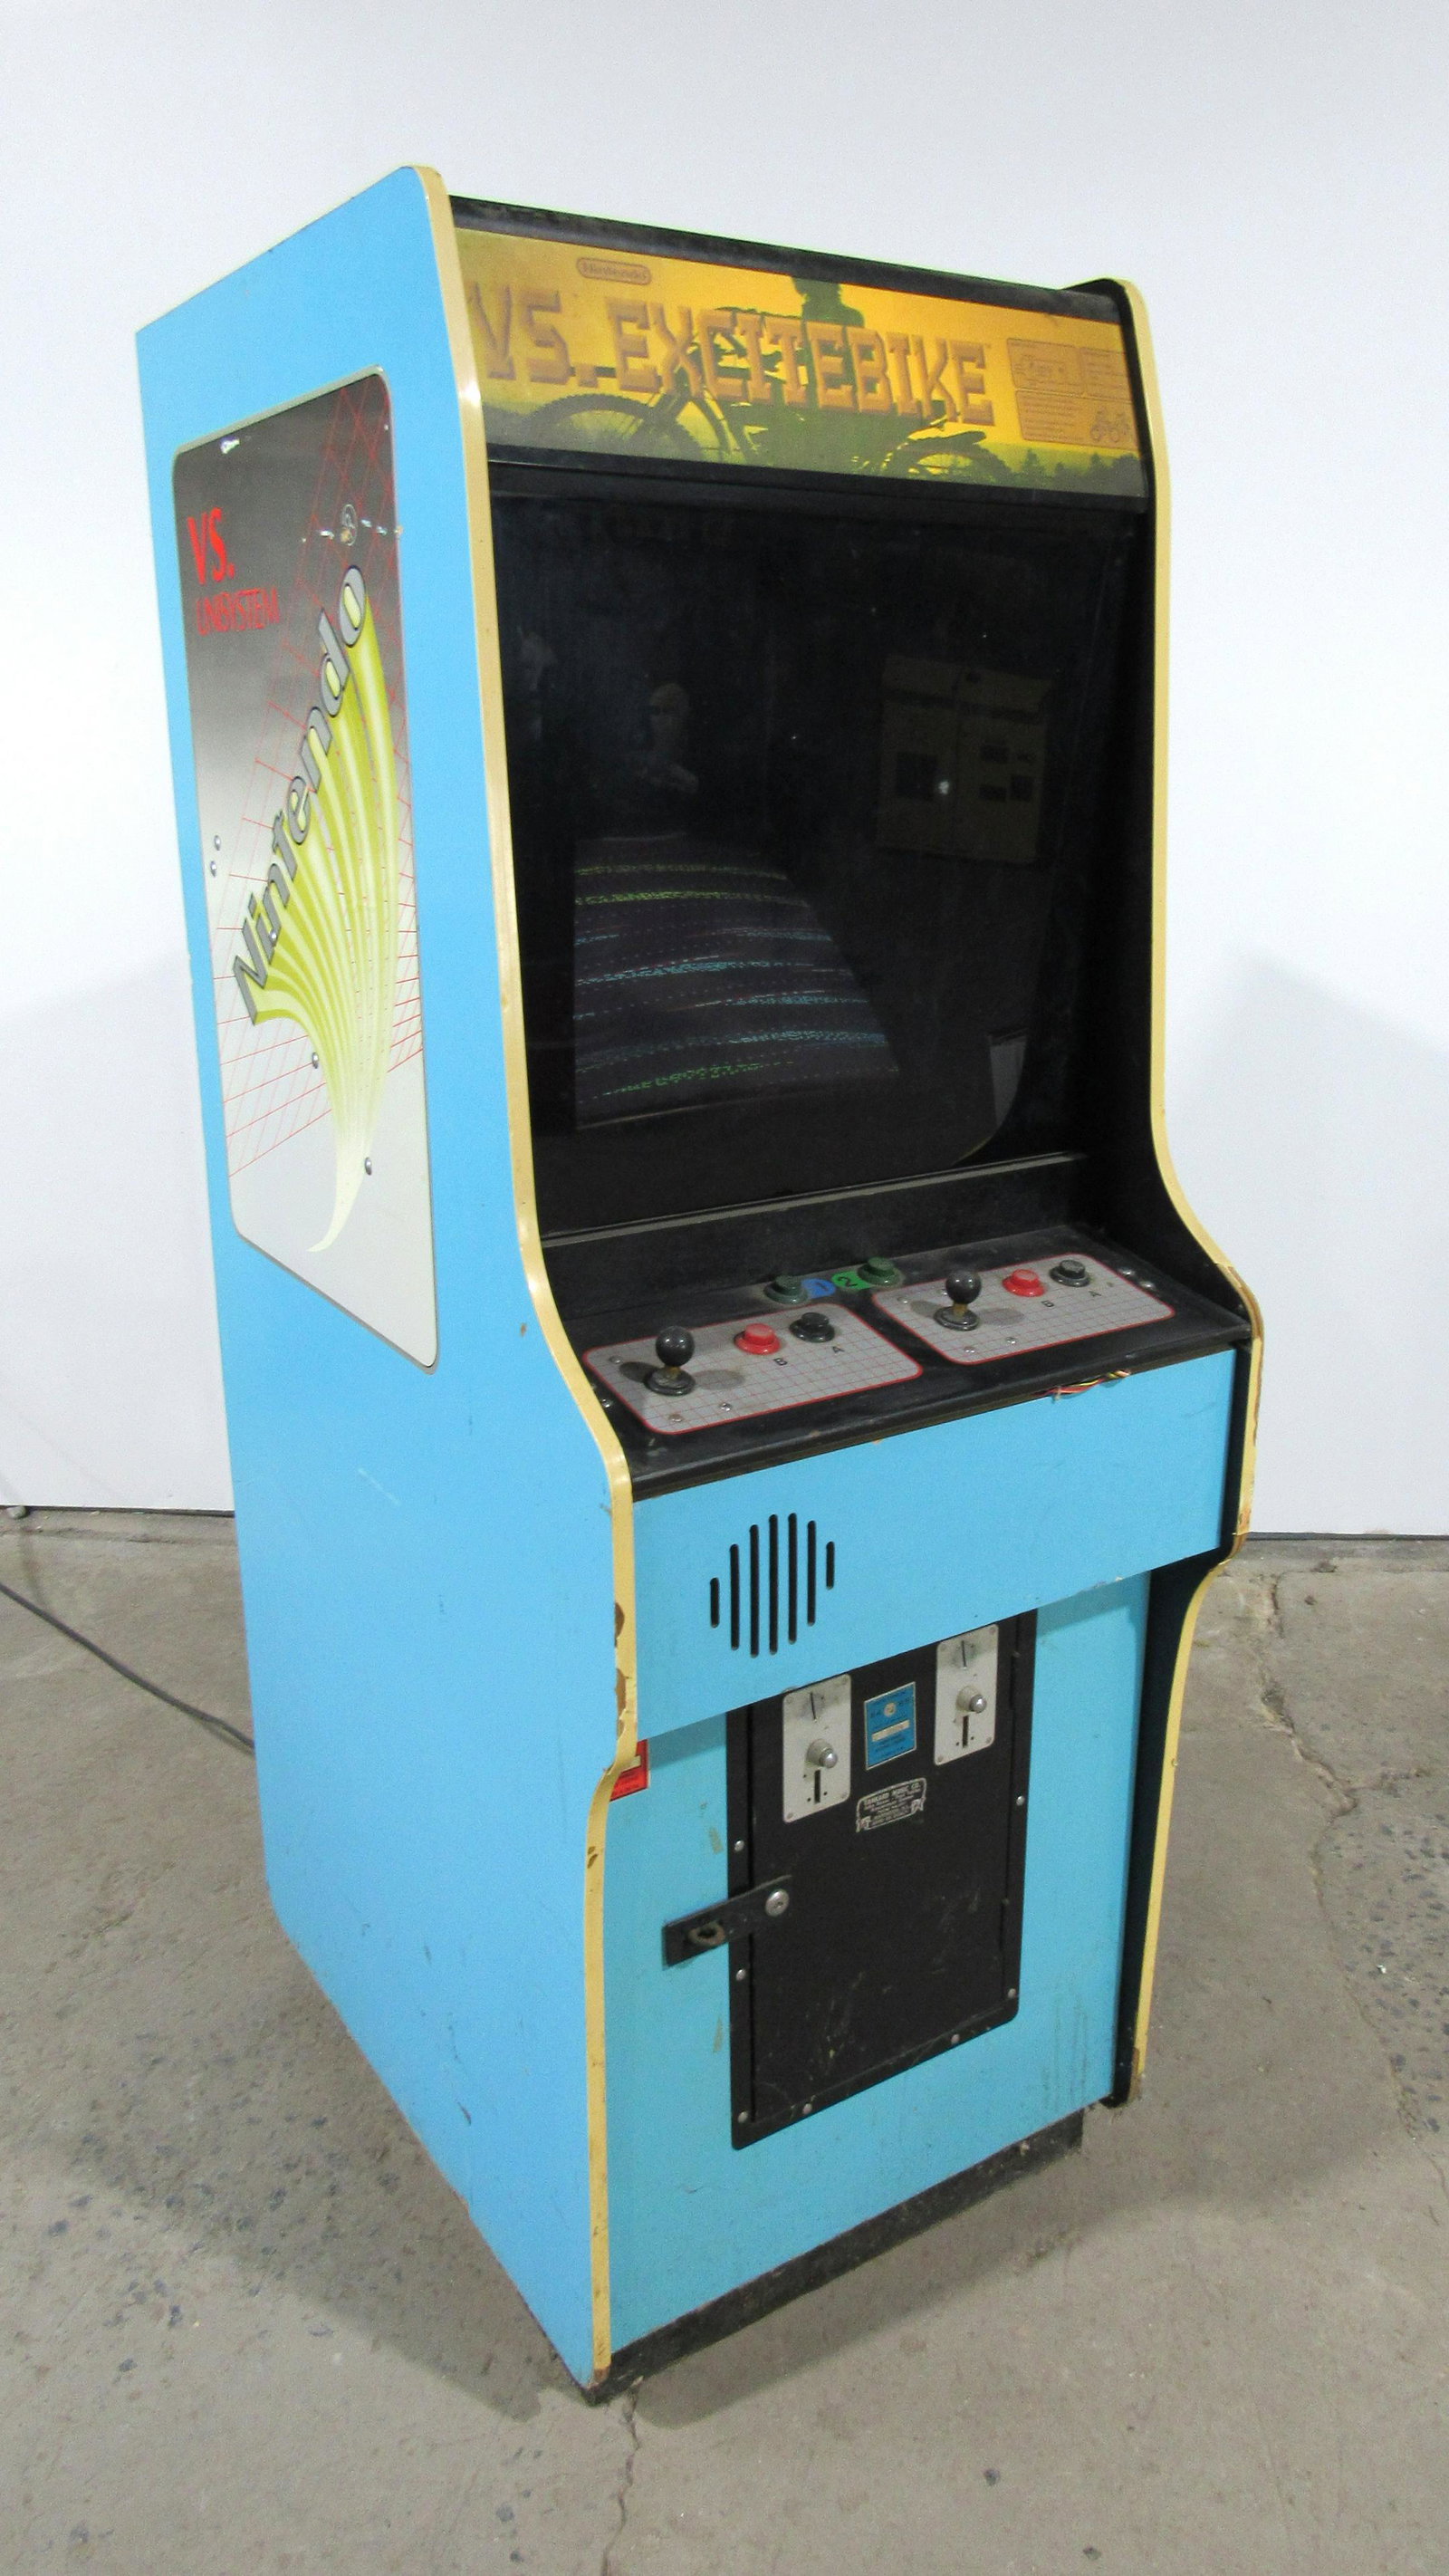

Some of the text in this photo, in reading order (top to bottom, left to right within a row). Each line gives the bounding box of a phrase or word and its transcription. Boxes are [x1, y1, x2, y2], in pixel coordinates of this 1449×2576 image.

[465, 279, 599, 389] VS.
[605, 295, 995, 426] EXCITEBIKE
[187, 506, 235, 585] VS.
[232, 564, 367, 1026] Nintendo
[837, 1276, 859, 1288] 2
[1041, 1300, 1054, 1308] B
[773, 1346, 845, 1366] B A
